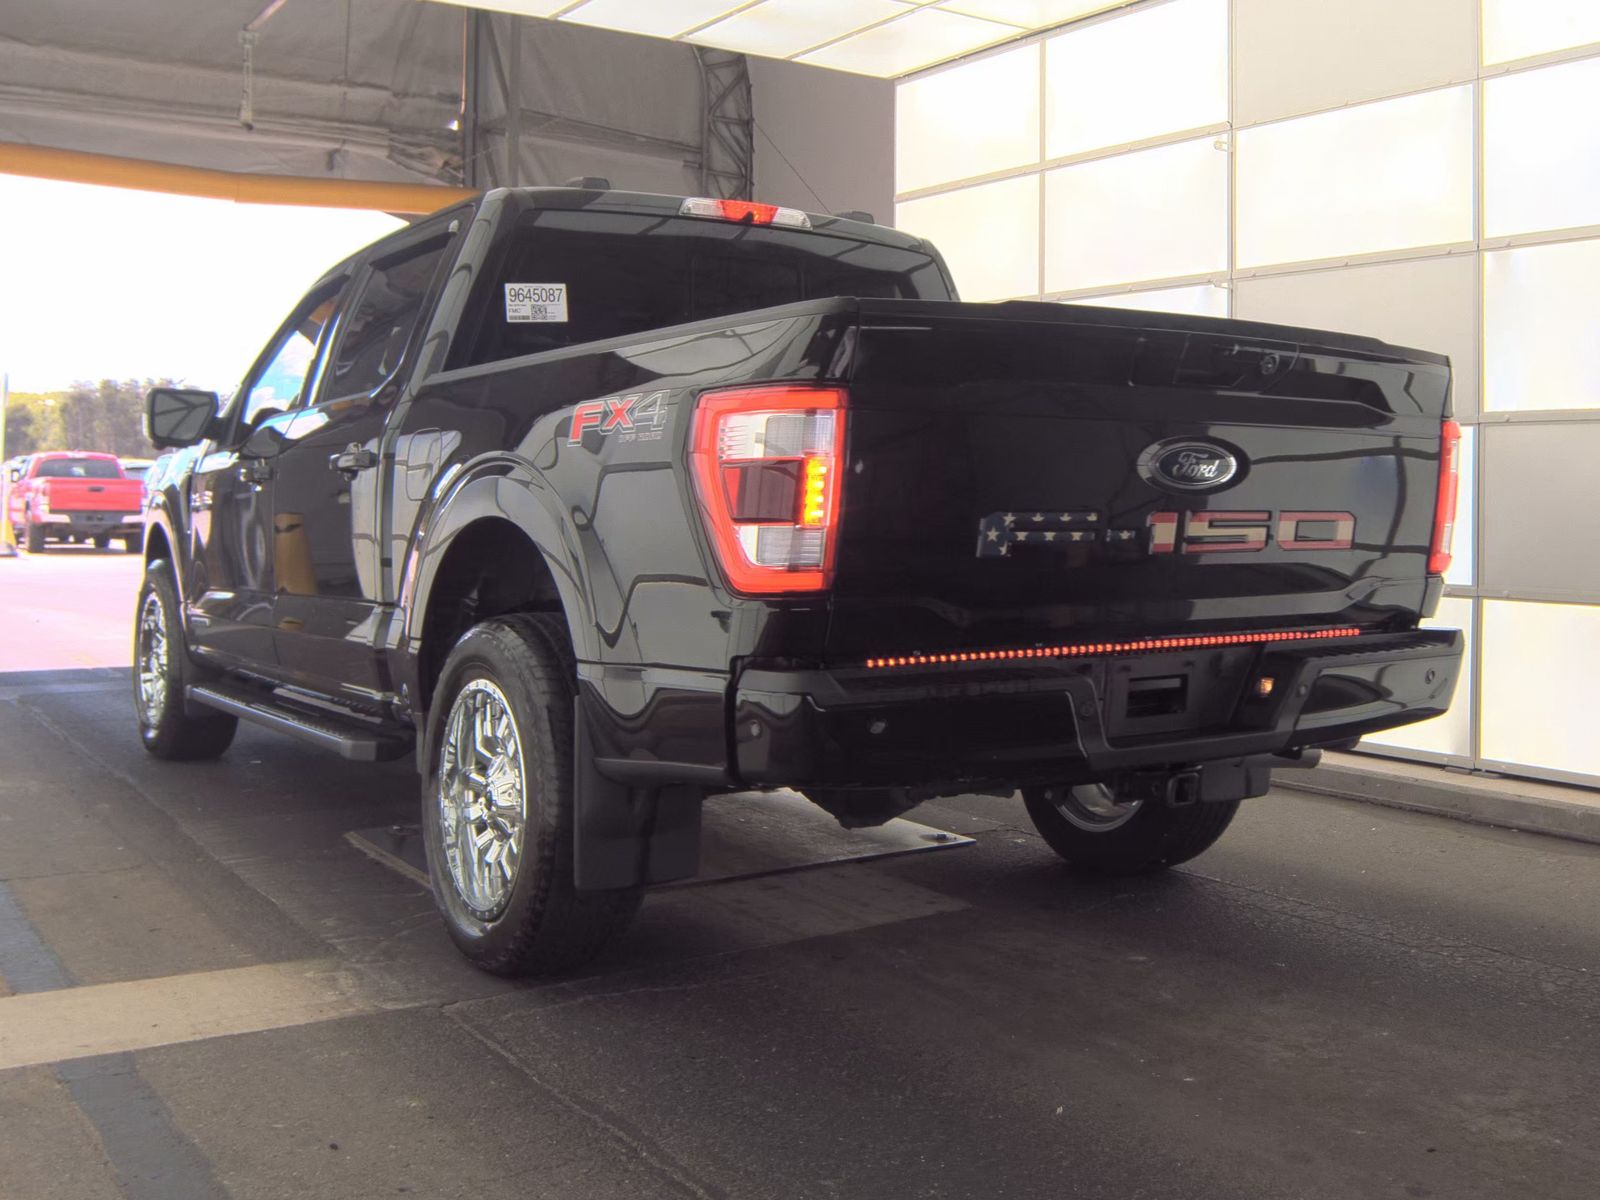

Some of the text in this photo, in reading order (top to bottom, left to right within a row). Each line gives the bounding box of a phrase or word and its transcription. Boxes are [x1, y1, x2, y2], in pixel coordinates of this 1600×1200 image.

[508, 287, 562, 302] 9645087
[567, 390, 670, 447] FX4
[1172, 451, 1220, 478] Ford
[976, 510, 1357, 558] F-150
